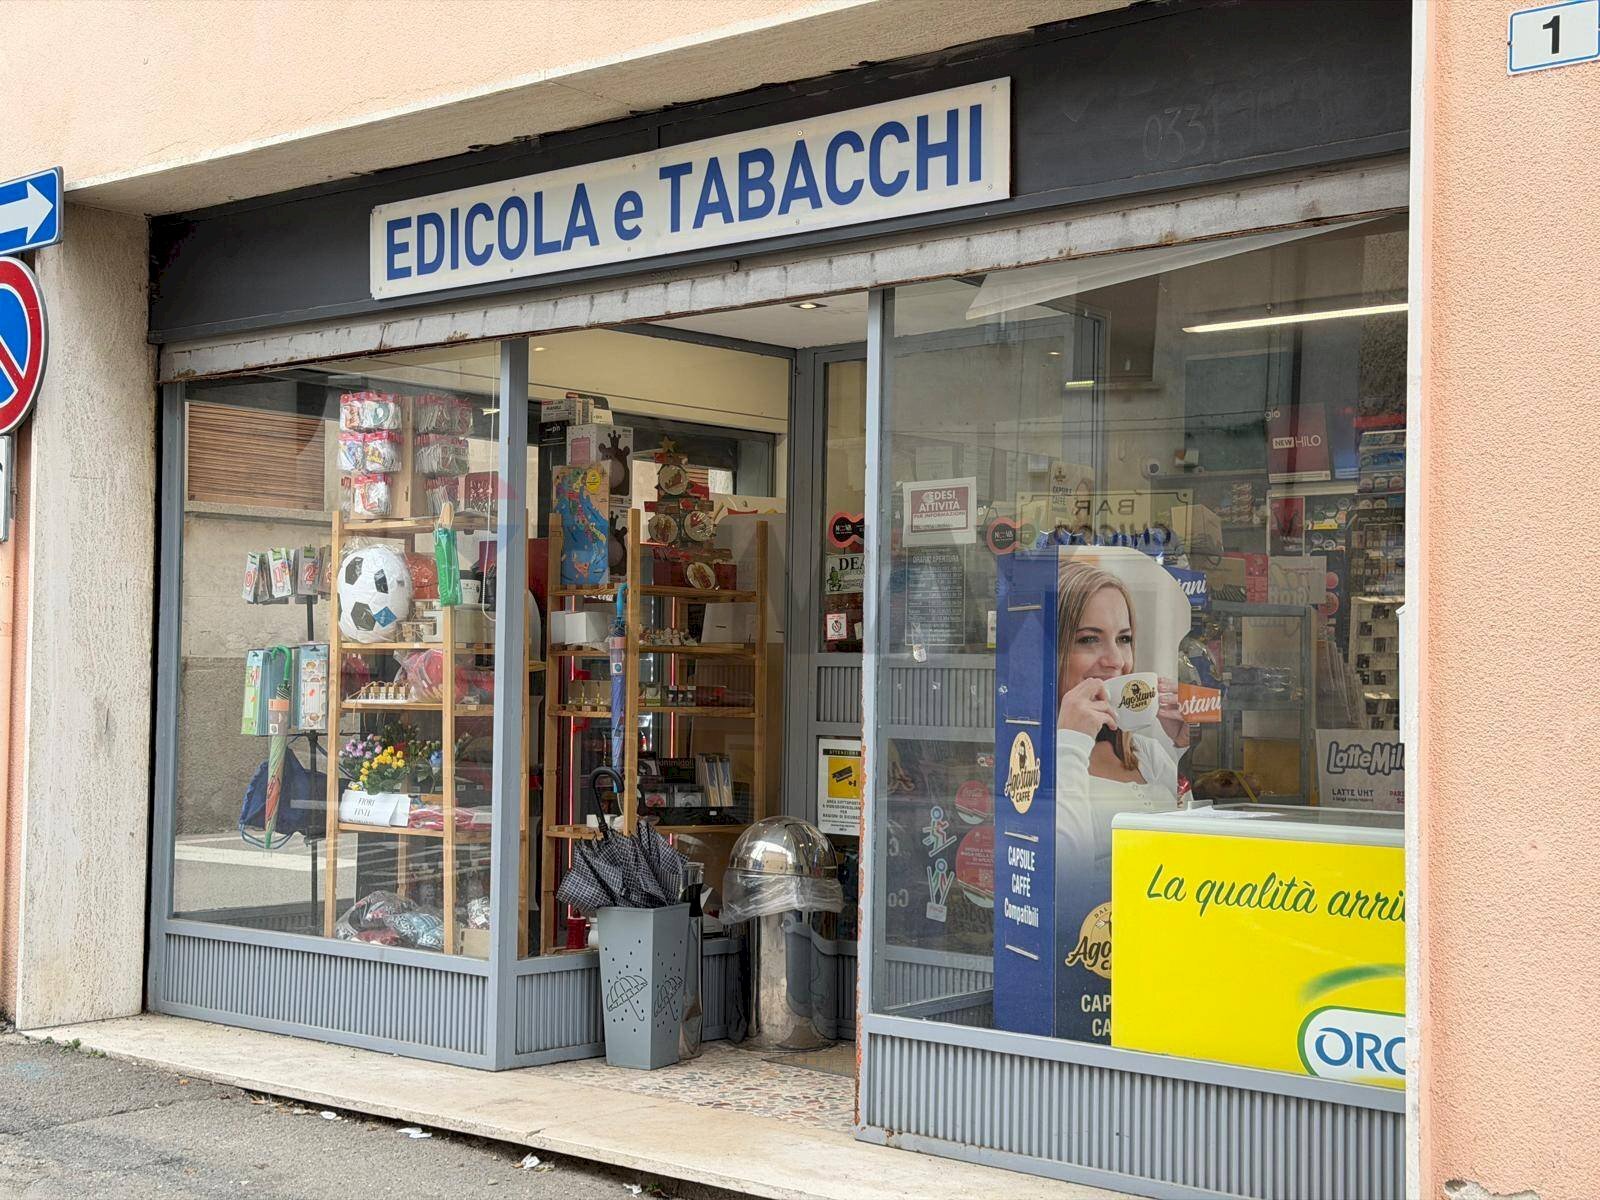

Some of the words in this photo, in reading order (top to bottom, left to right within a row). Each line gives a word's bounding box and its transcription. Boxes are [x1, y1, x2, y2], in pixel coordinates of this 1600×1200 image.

[1542, 15, 1560, 55] 1
[386, 182, 600, 281] EDICOLA
[614, 190, 644, 241] e
[659, 103, 982, 233] TABACCHI
[1274, 438, 1293, 448] NEW
[1295, 435, 1321, 447] HILO
[919, 498, 961, 513] ATTIVITÀ
[1118, 687, 1156, 709] Agostani
[1004, 759, 1040, 799] Agostani
[1332, 788, 1355, 797] LATTE
[1357, 788, 1374, 797] UHT
[1007, 845, 1036, 872] CAPSULE
[1011, 872, 1031, 898] CAFFÈ
[1146, 864, 1187, 902] La
[1195, 872, 1318, 918] qualità
[1004, 897, 1039, 928] Compatibili
